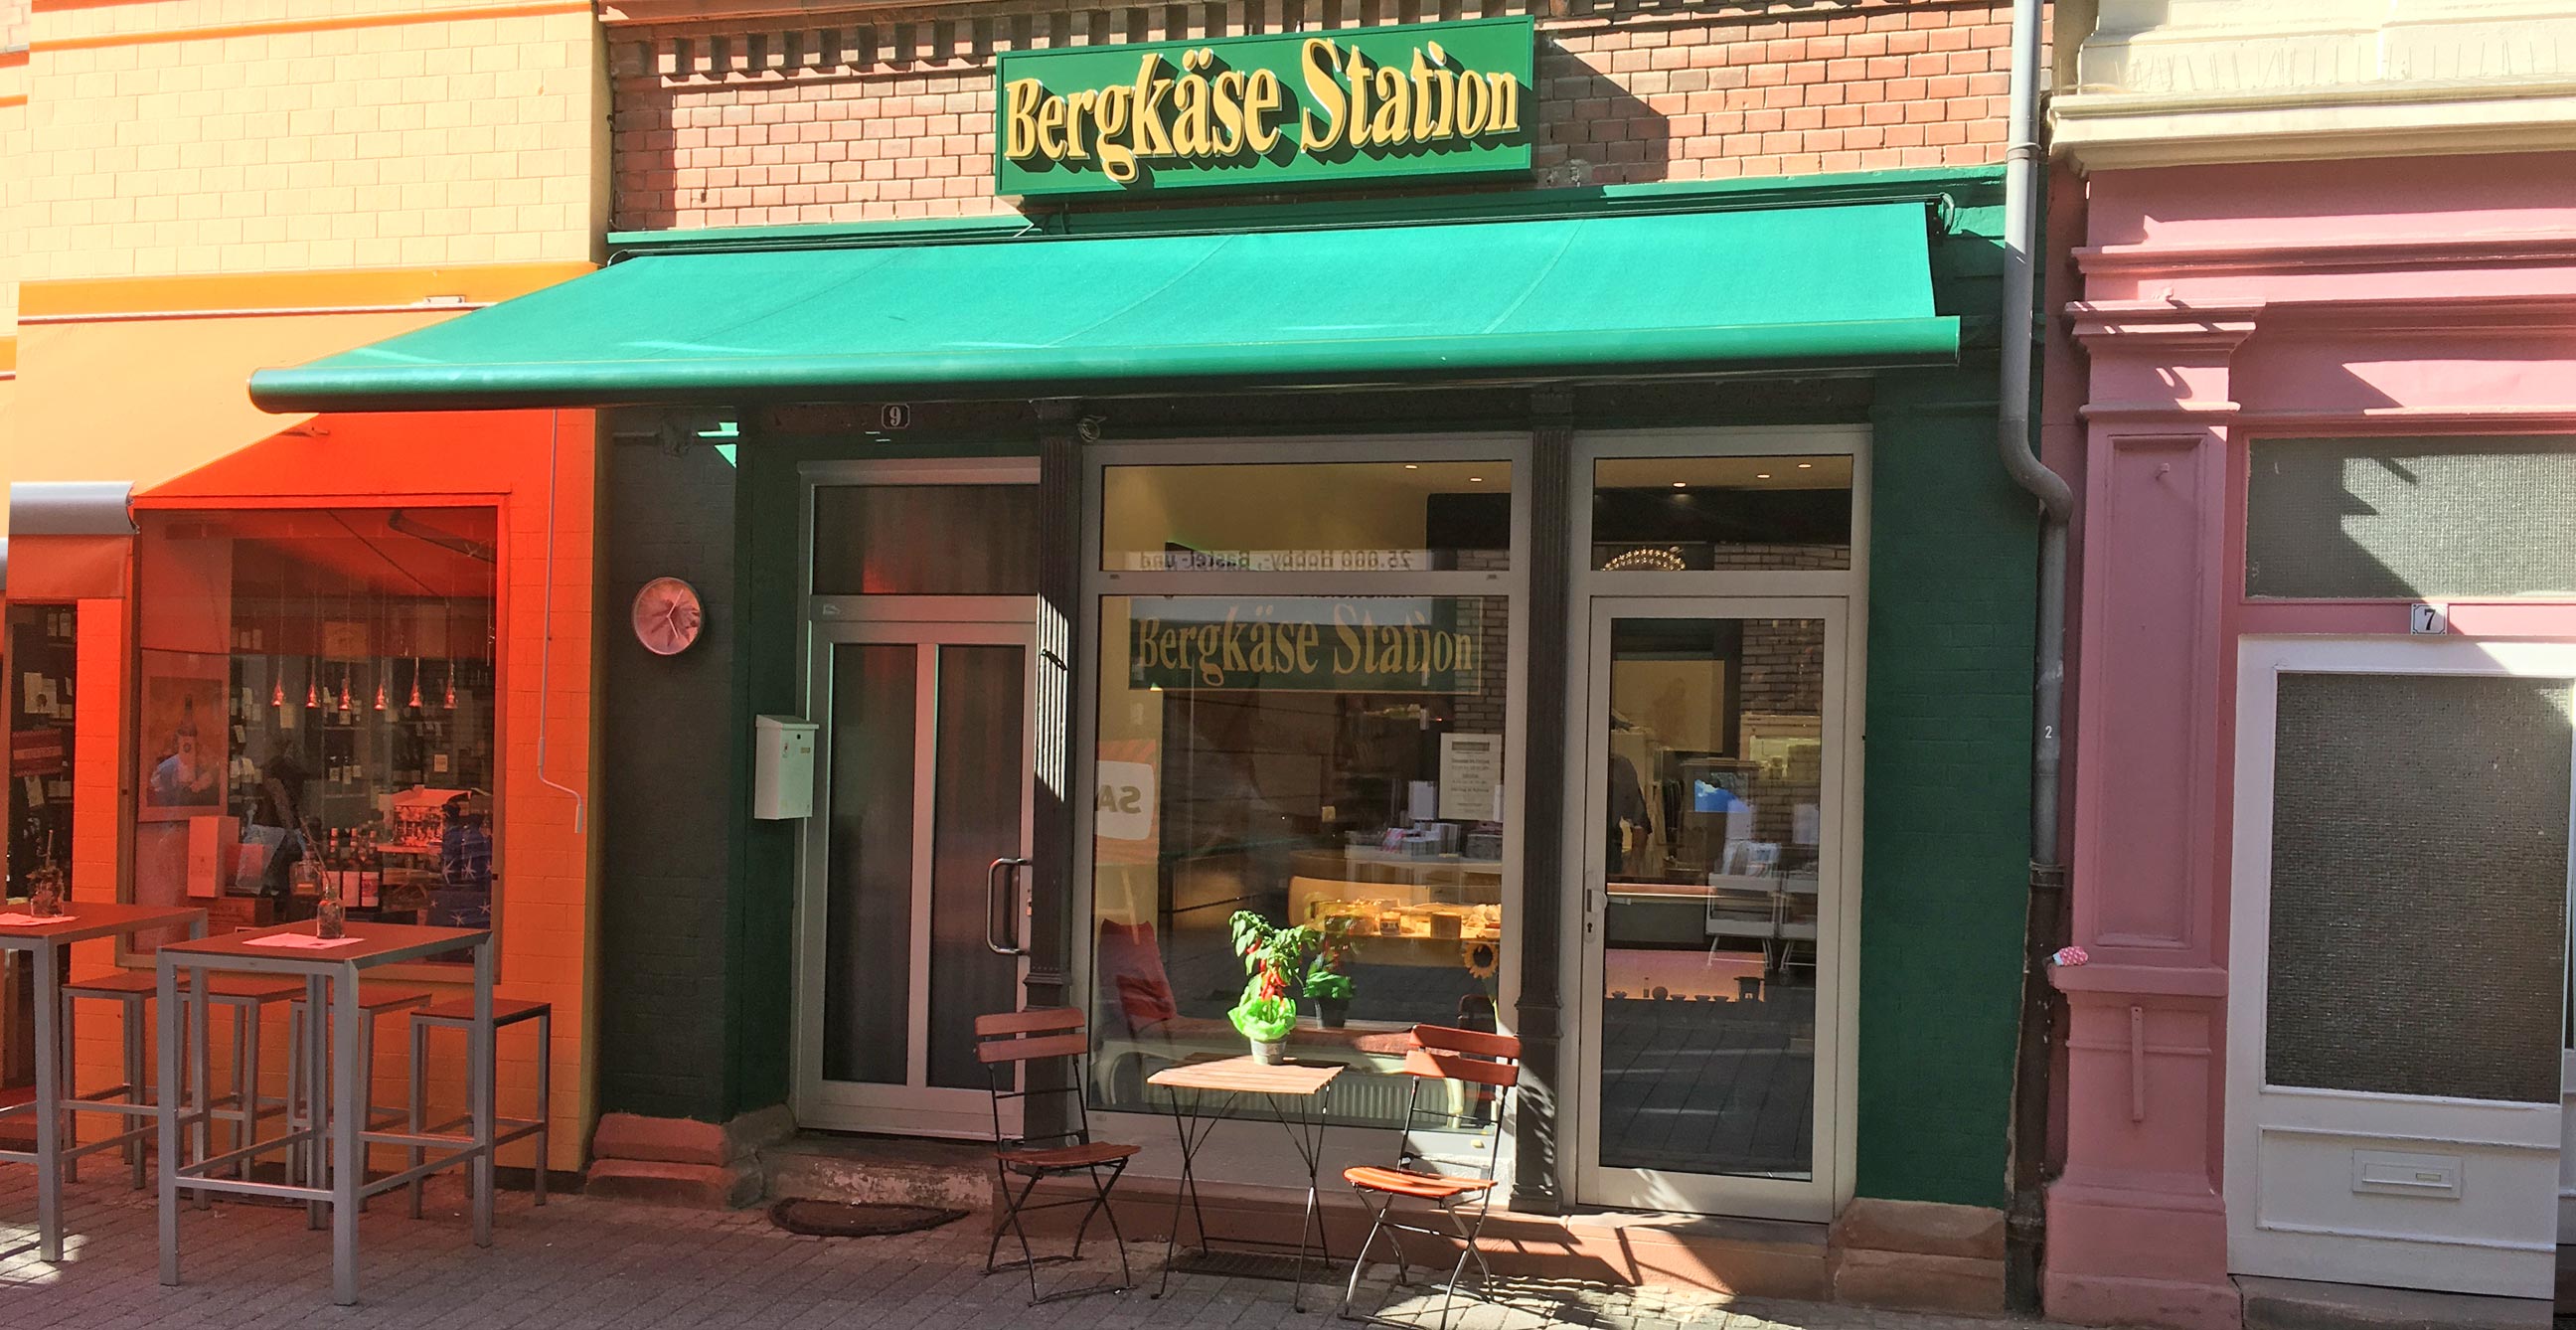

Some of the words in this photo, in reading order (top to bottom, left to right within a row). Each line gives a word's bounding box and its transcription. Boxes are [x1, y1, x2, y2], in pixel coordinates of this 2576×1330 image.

[1004, 47, 1283, 184] Bergkäse
[1300, 38, 1521, 152] Station
[889, 406, 901, 426] 9
[2424, 608, 2436, 631] 7
[1140, 604, 1319, 686] Bergkäse
[1333, 603, 1474, 674] Station
[2044, 725, 2052, 739] 2
